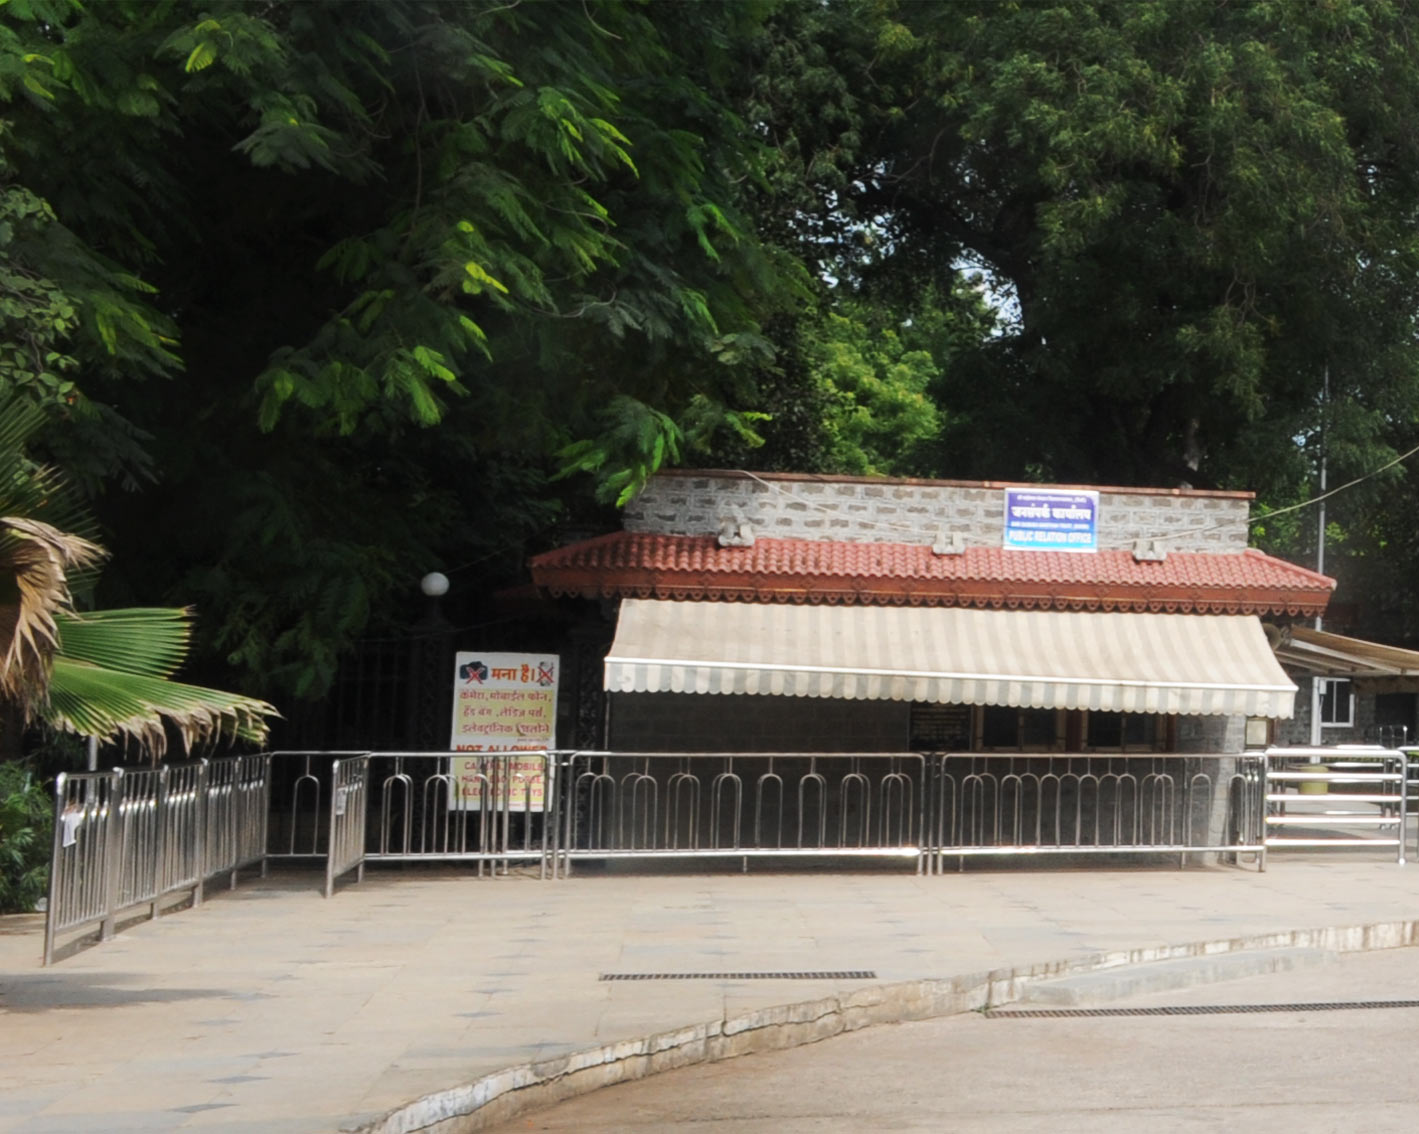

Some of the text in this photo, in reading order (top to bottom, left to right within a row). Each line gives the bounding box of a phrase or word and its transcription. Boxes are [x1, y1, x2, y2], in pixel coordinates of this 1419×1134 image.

[491, 668, 517, 681] मना
[456, 744, 548, 752] NOT ALLOWED
[520, 787, 543, 797] TYS
